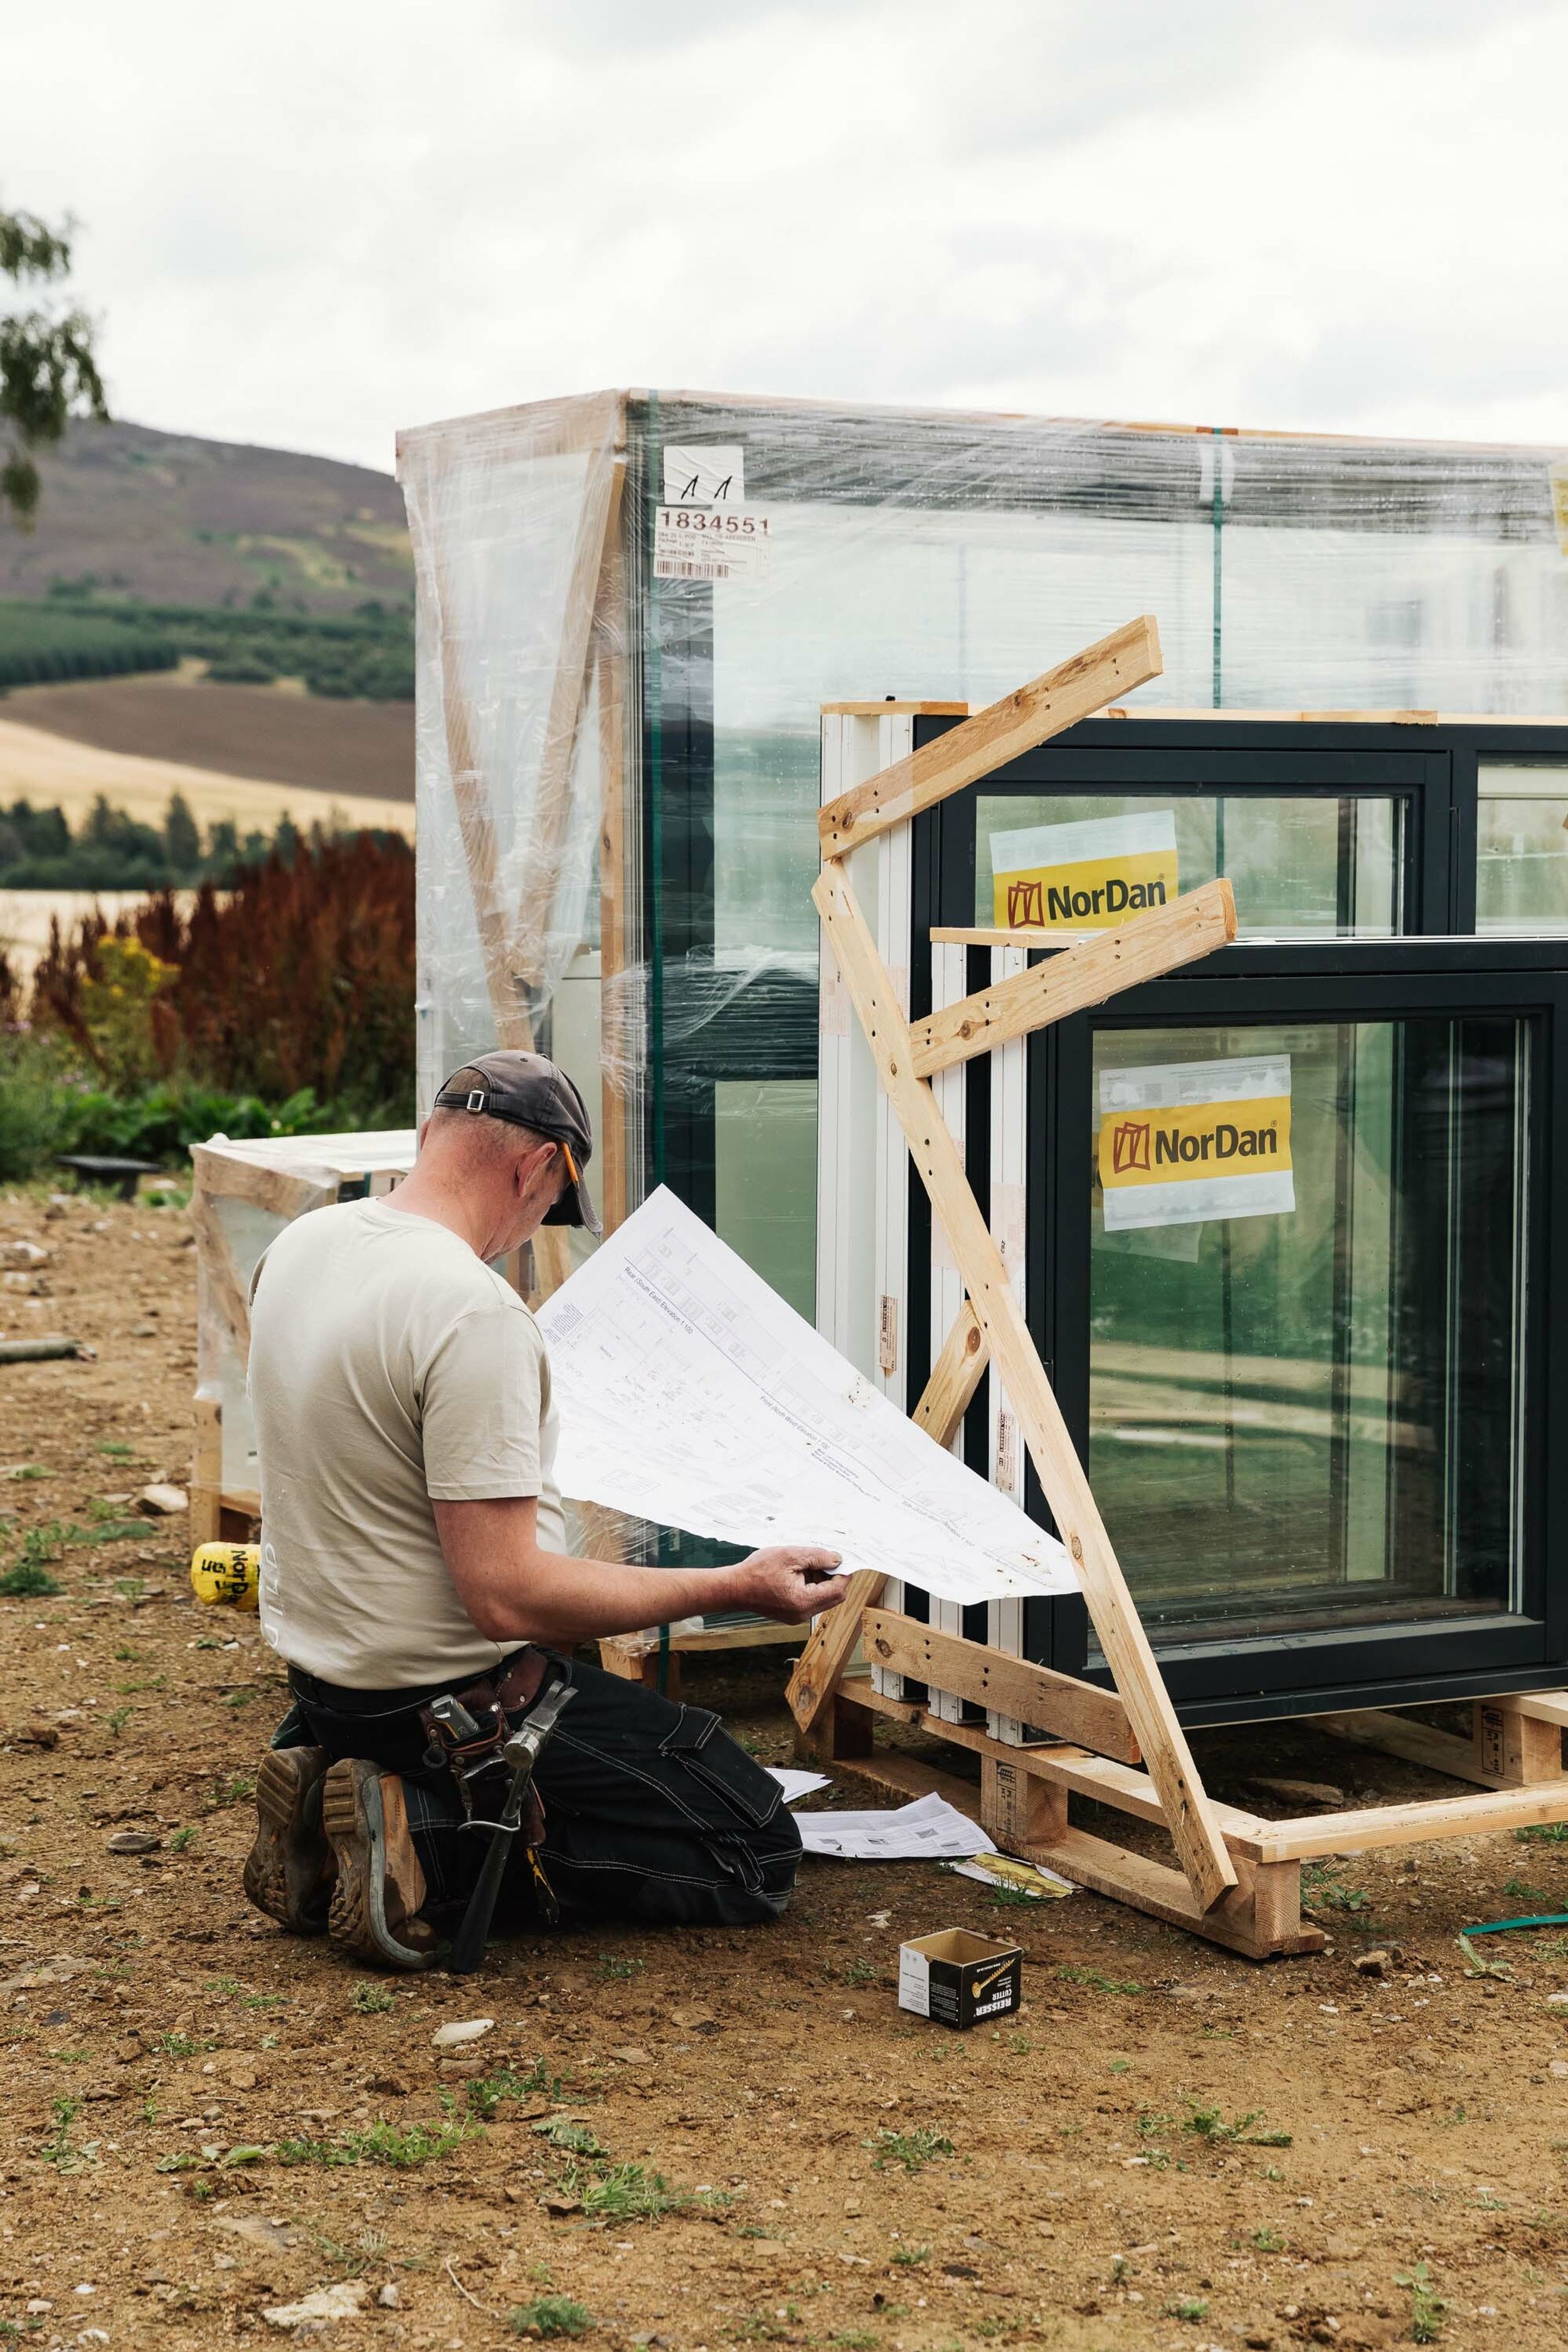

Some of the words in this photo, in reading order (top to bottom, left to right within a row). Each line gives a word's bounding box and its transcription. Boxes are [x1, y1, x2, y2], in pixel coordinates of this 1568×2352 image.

[660, 511, 768, 536] 1834551
[1048, 879, 1166, 920] NorDan
[1156, 1125, 1277, 1164] NorDan
[624, 1266, 636, 1279] Rear
[660, 1301, 681, 1323] Elevation
[976, 1998, 1012, 2016] REISSER
[992, 1989, 1012, 2001] CUTTER
